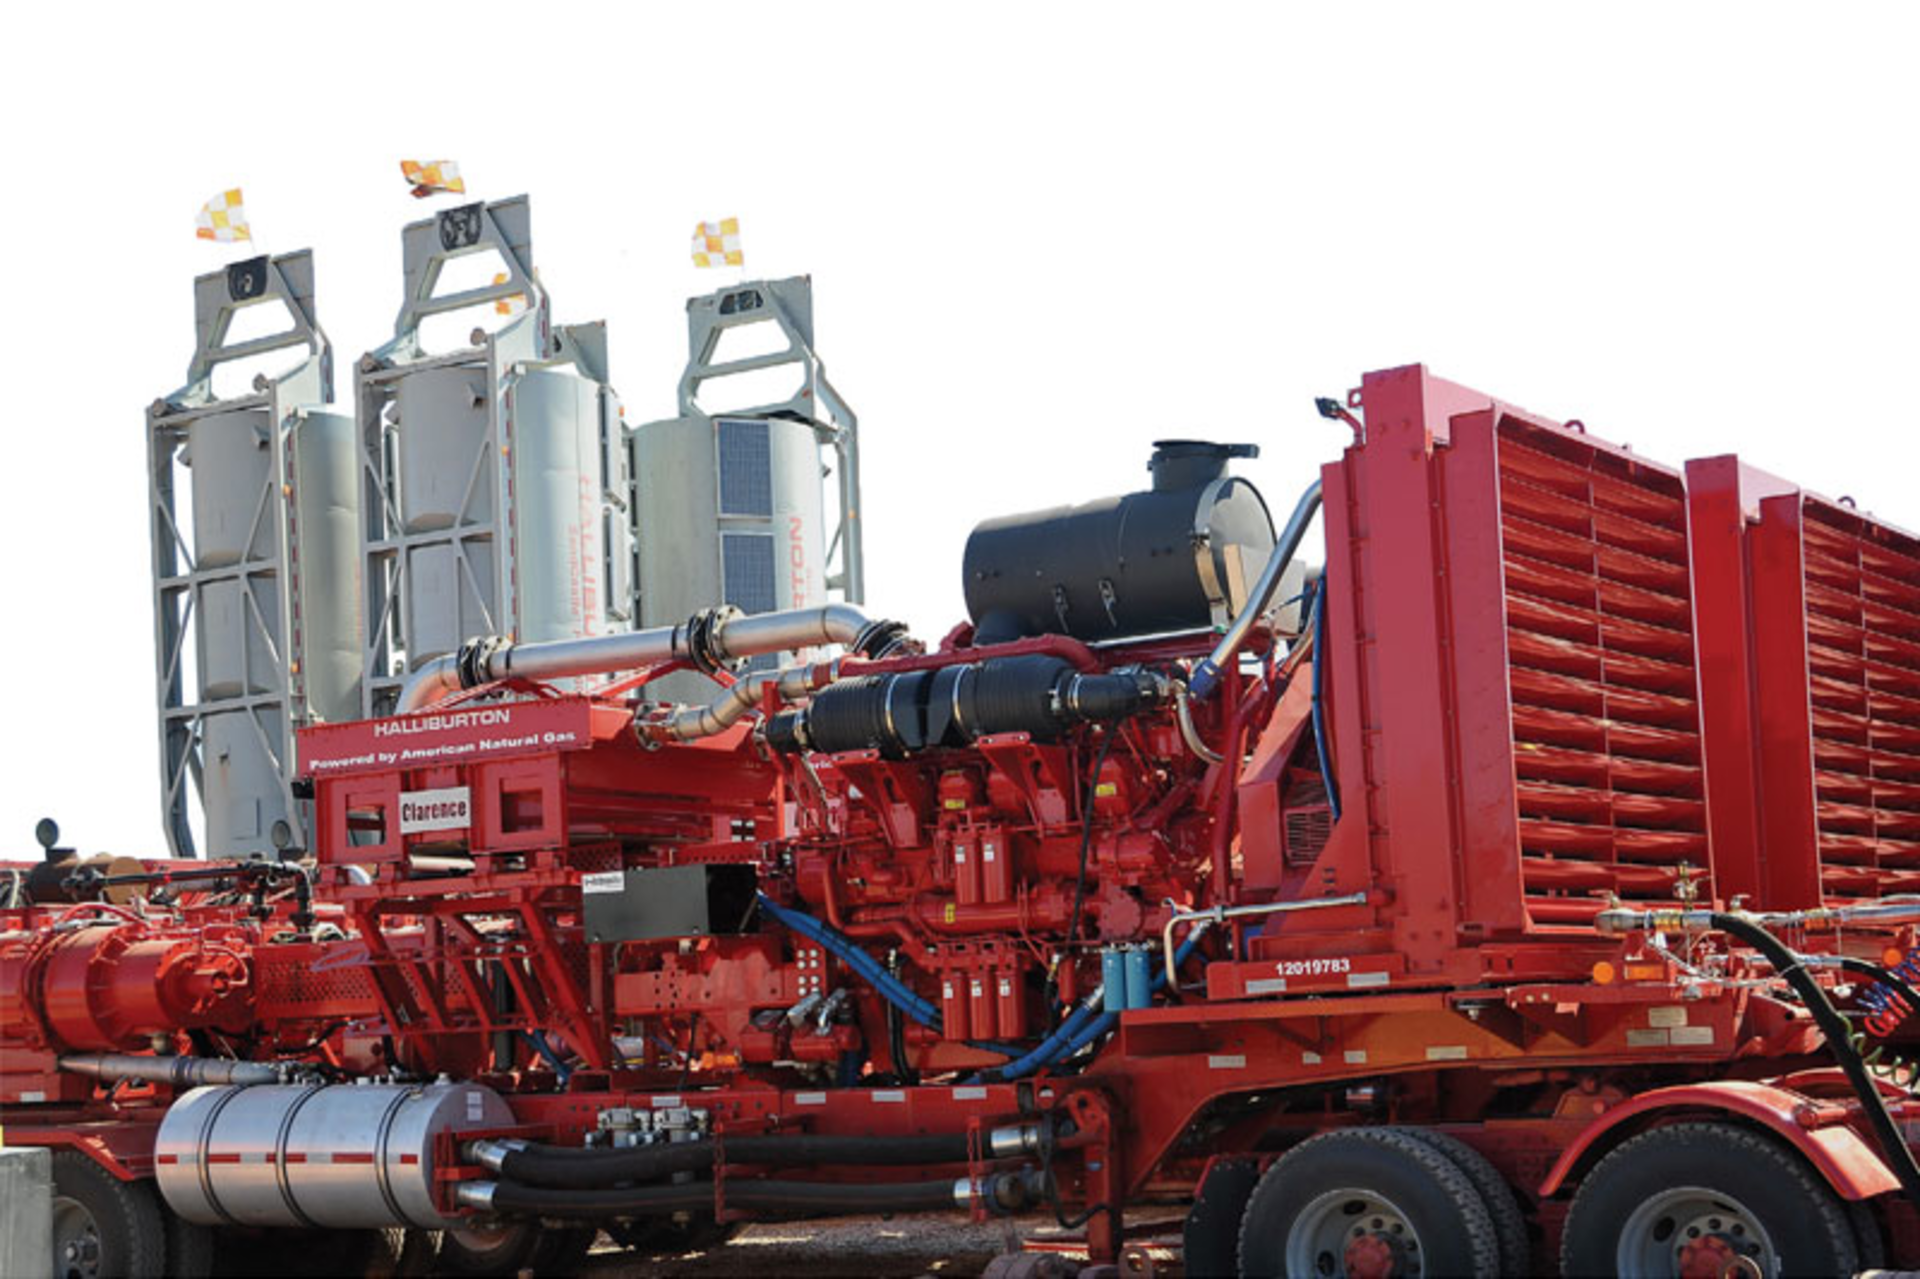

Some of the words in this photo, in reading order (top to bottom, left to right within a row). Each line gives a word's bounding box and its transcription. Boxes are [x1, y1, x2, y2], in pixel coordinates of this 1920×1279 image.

[374, 709, 510, 737] HALLIBURTON
[309, 753, 375, 770] Powered
[378, 751, 397, 763] by
[401, 743, 476, 759] American
[479, 733, 539, 751] Natural
[543, 731, 576, 743] Gas
[402, 800, 467, 822] Clarence
[1276, 957, 1350, 975] 12019783
